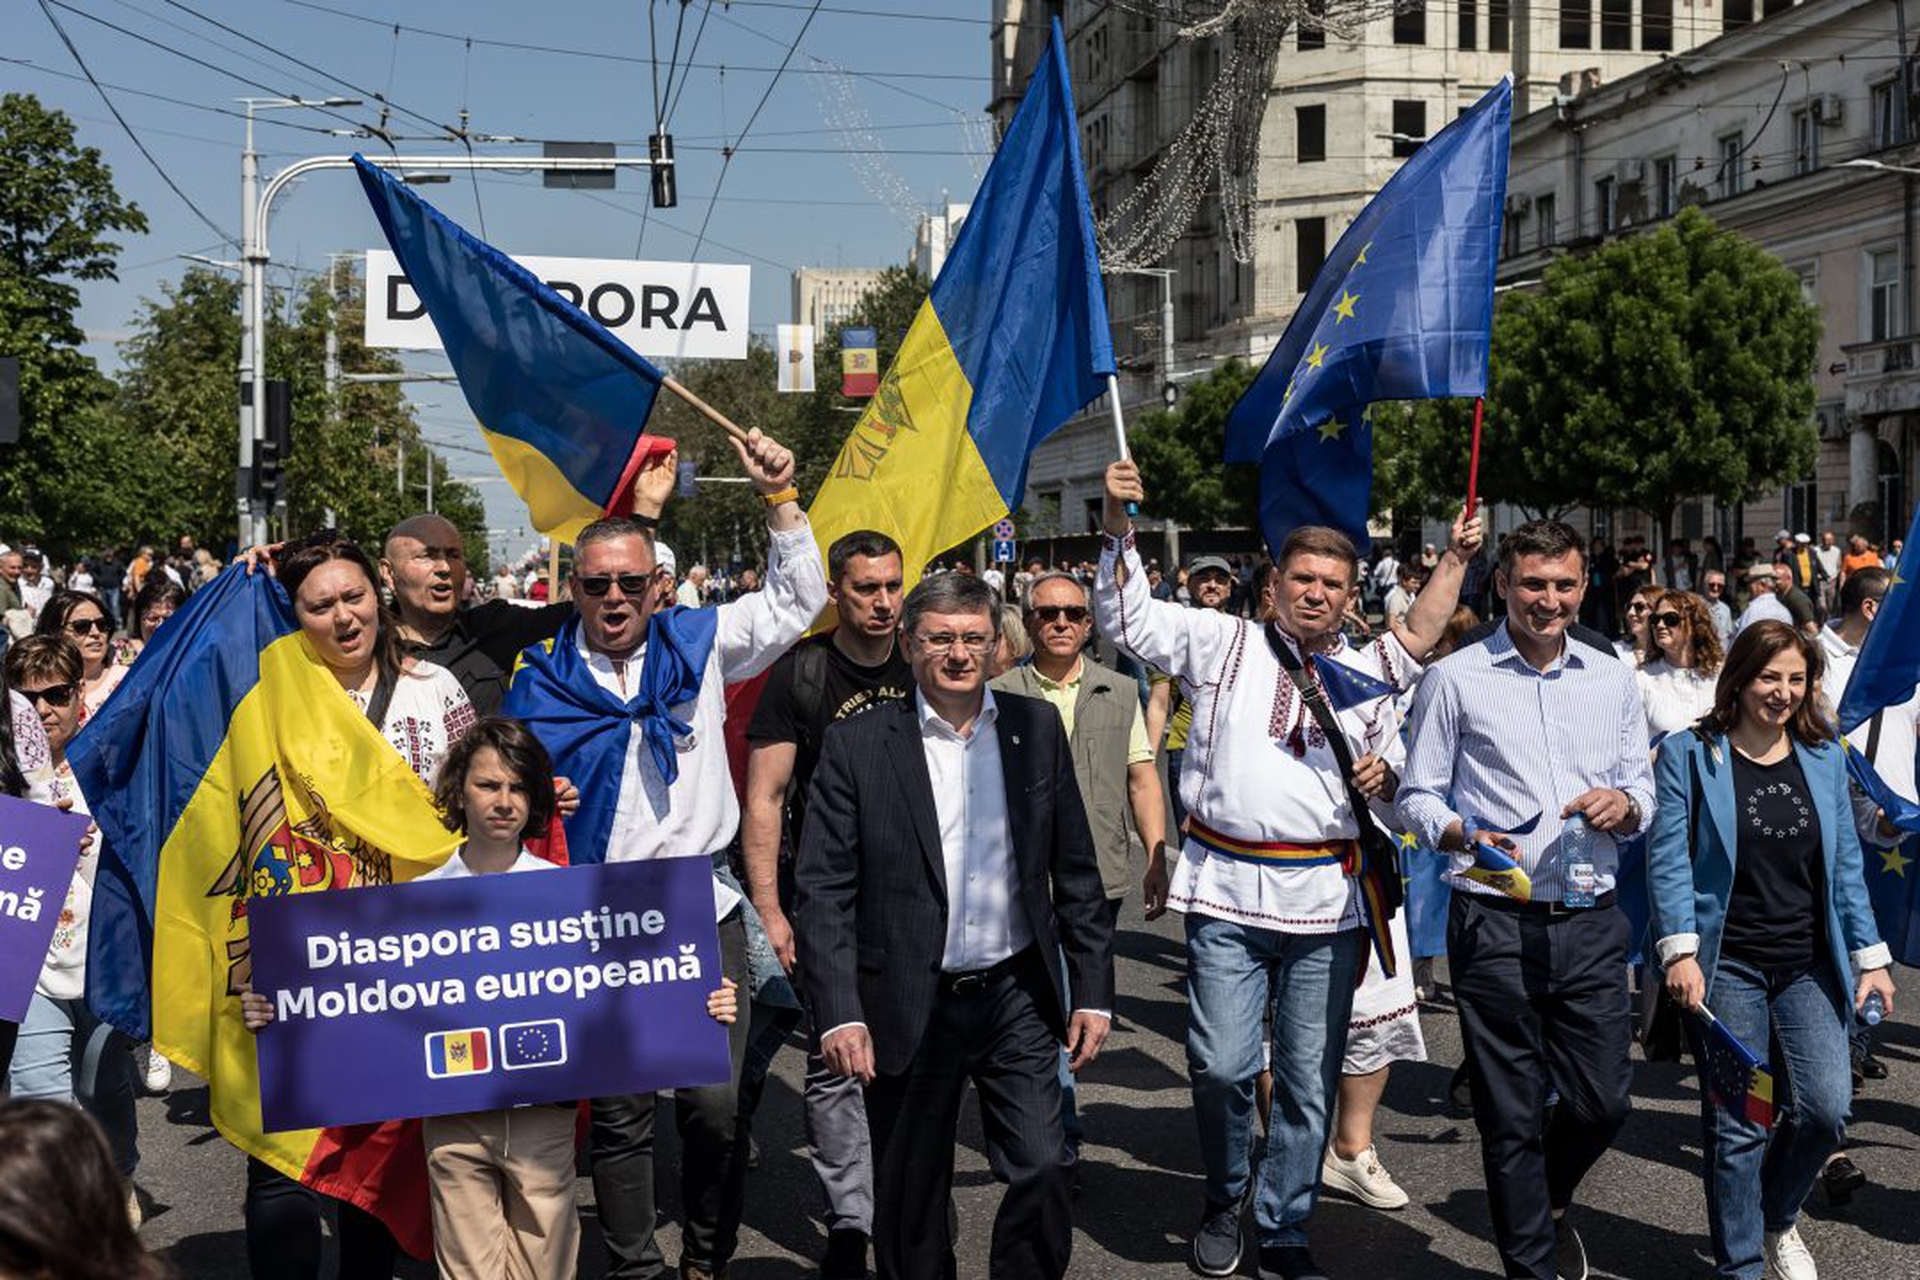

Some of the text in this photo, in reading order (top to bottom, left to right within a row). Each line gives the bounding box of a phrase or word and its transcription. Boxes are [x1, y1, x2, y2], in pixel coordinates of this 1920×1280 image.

[306, 906, 666, 969] Diaspora susține
[277, 943, 702, 1022] Moldova europeană
